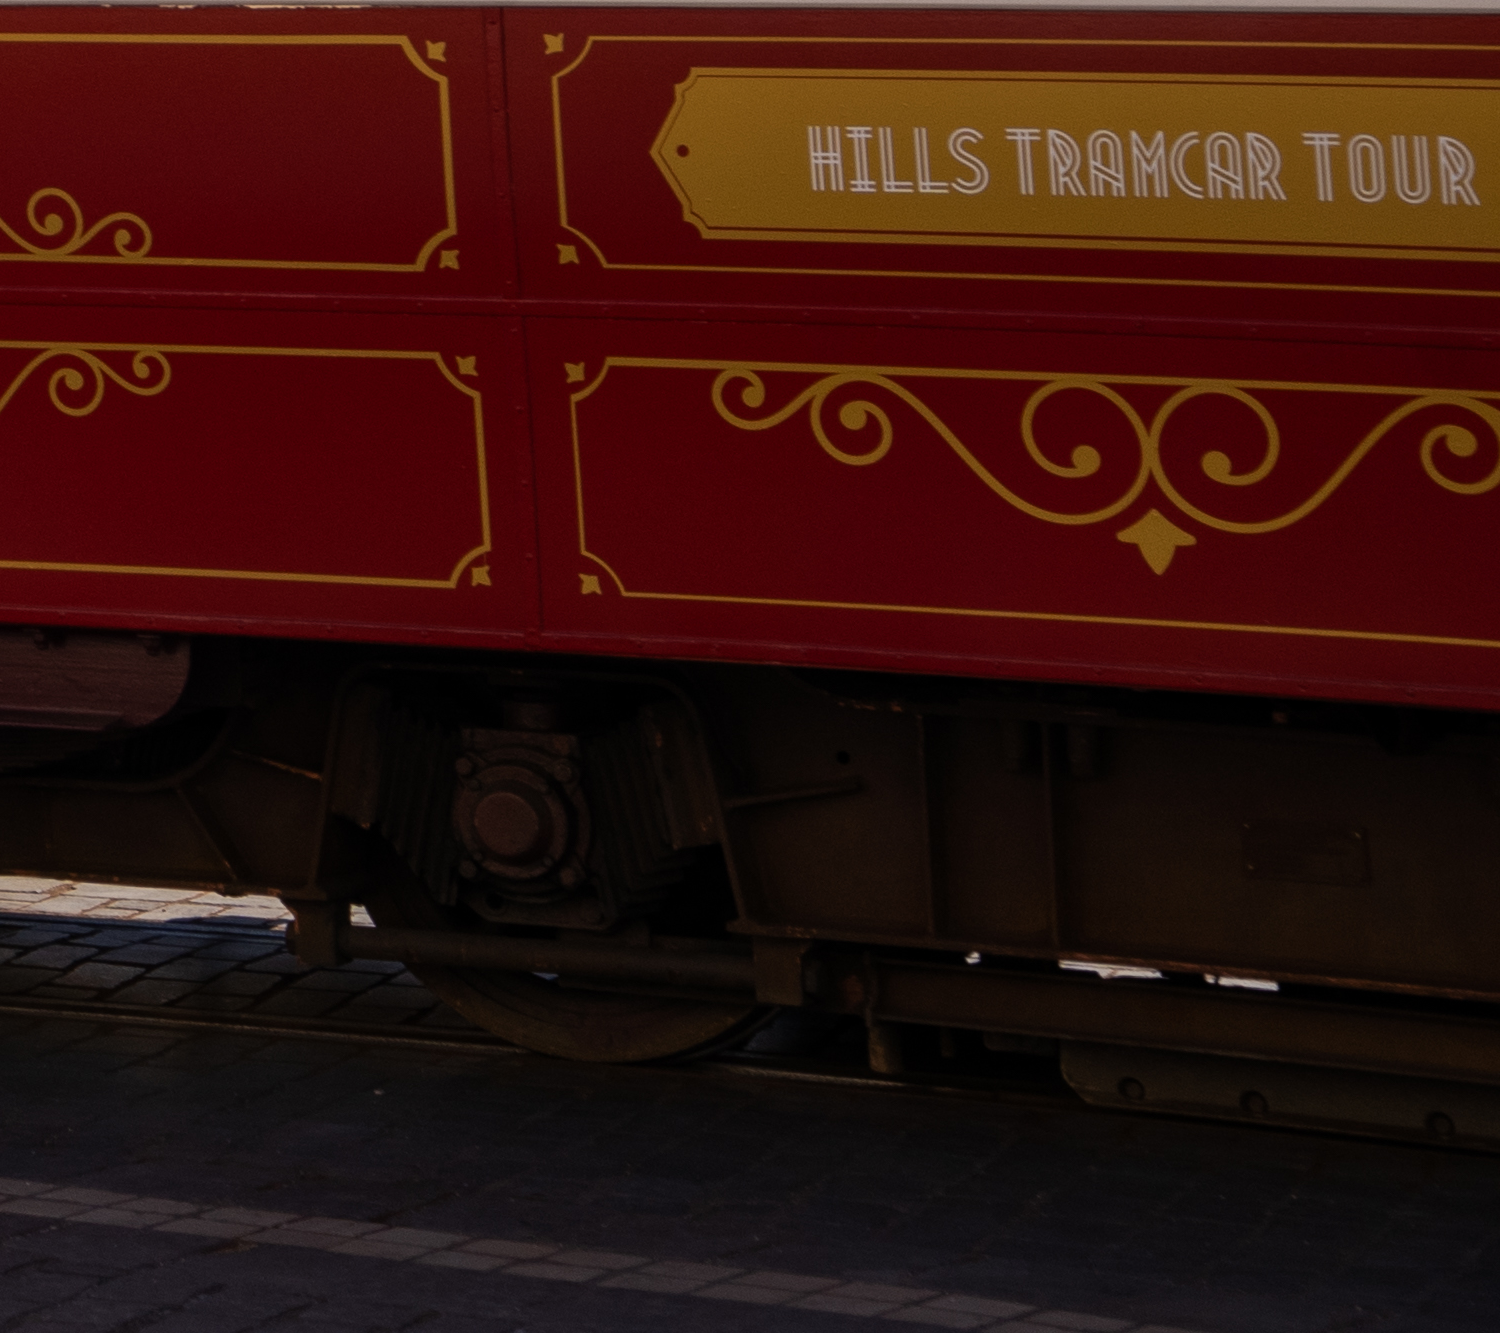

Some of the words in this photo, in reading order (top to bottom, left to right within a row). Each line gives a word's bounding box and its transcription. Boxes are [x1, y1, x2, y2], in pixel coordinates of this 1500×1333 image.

[807, 125, 990, 195] HILLS
[1005, 127, 1288, 201] TRAMCAR
[1302, 132, 1482, 207] TOUR
